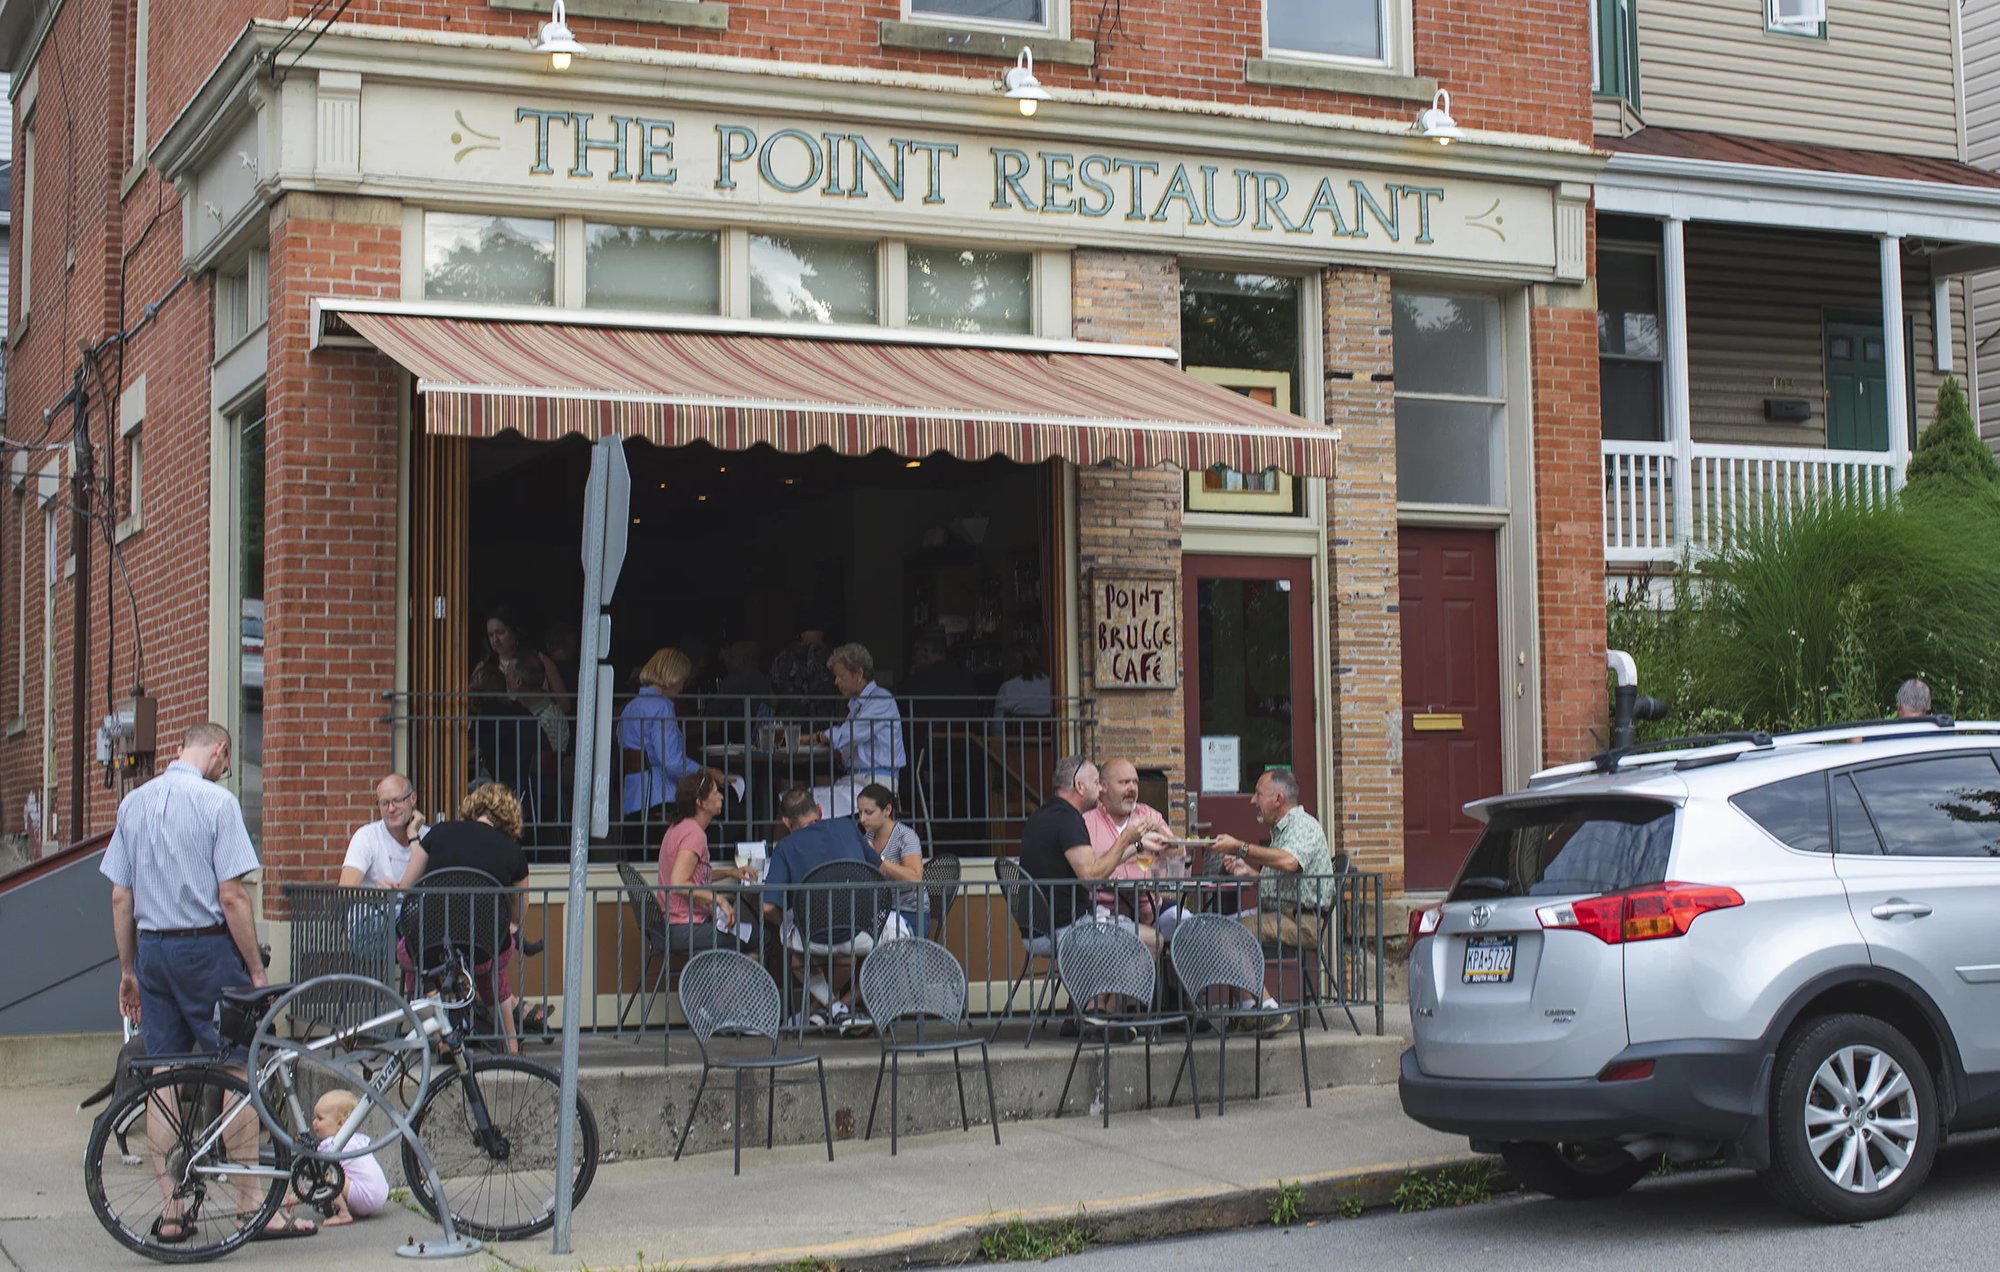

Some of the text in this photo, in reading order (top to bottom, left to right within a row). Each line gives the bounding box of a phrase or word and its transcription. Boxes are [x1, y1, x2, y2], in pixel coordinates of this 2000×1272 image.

[515, 107, 1445, 244] THE POINT RESTAURANT
[1105, 582, 1163, 620] POINT
[1098, 619, 1172, 652] BRUGGE
